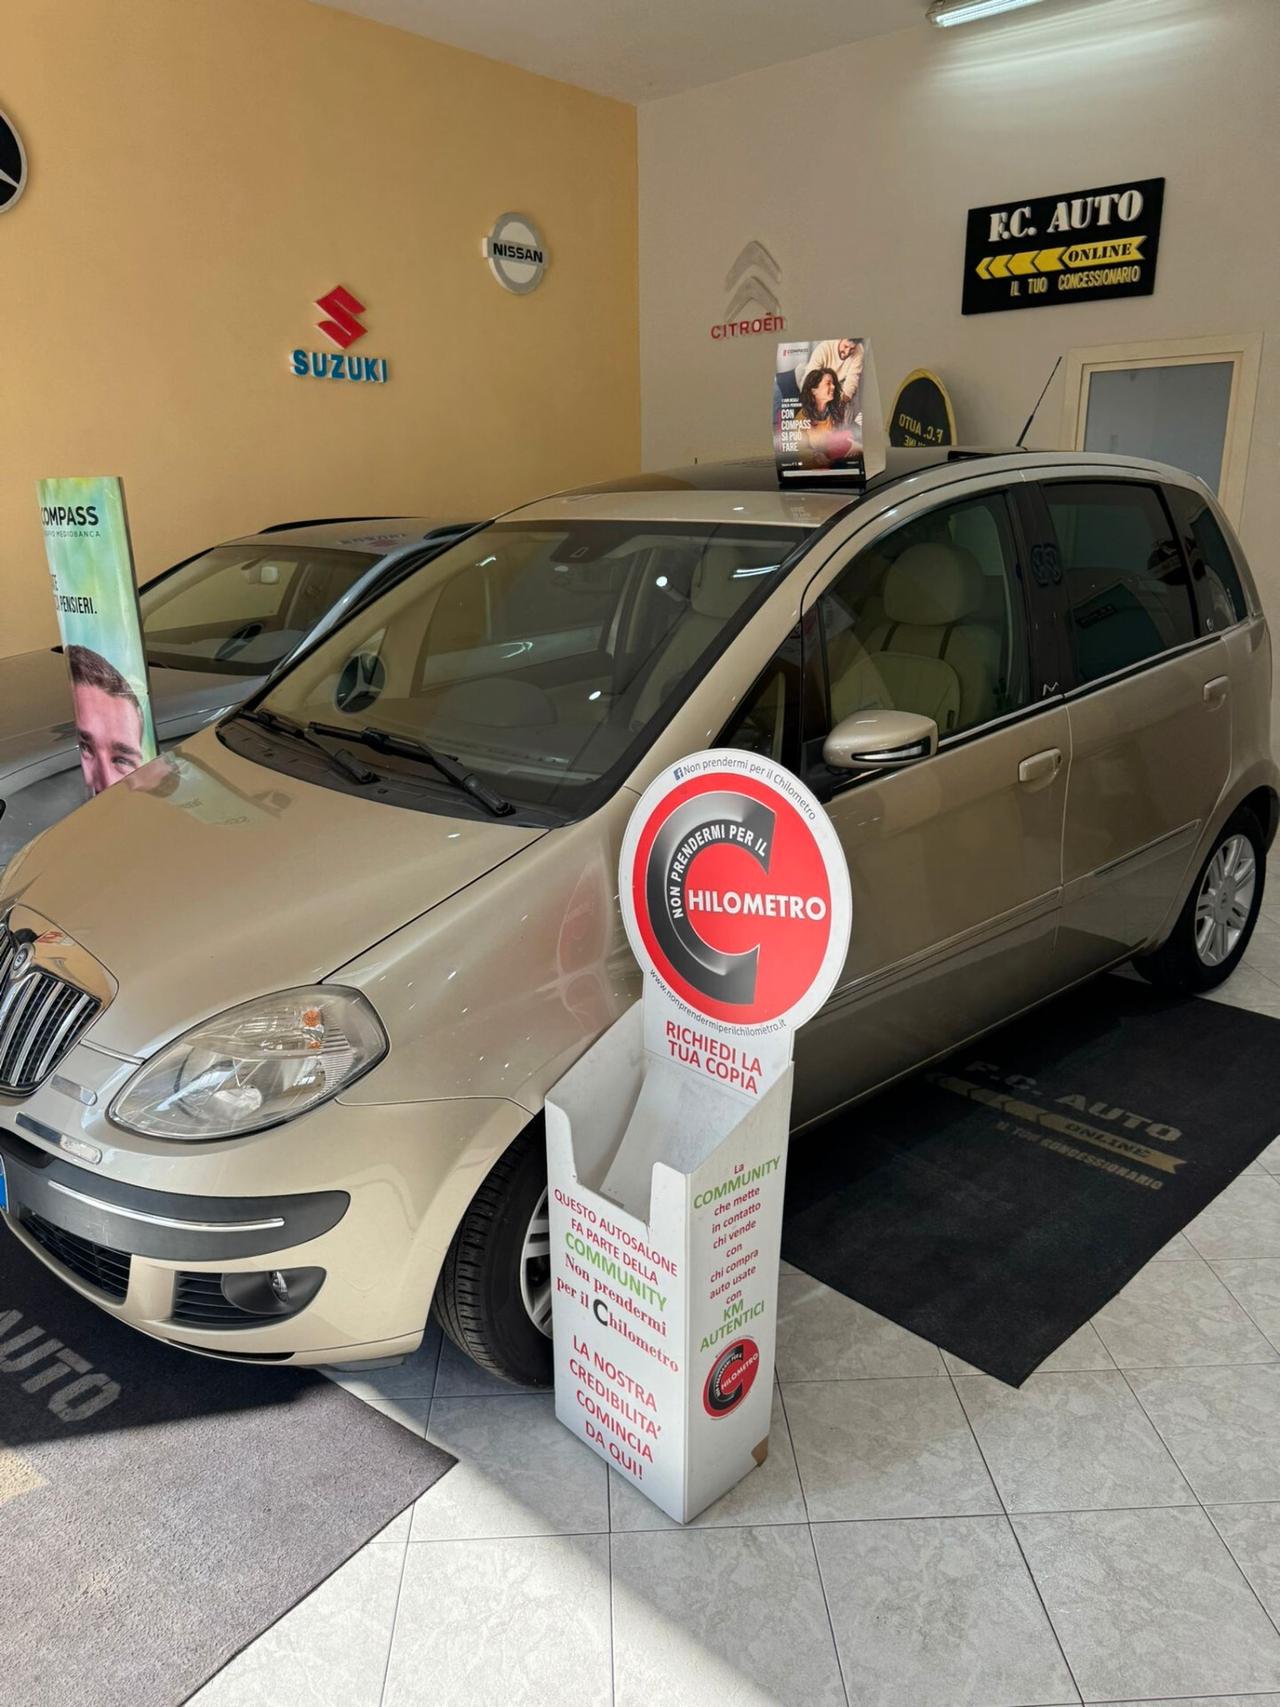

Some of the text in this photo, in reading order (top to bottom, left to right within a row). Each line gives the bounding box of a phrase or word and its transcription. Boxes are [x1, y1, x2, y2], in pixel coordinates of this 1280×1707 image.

[988, 190, 1144, 242] F.C. AUTO
[493, 242, 543, 263] NISSAN
[1068, 243, 1132, 263] ONLINE
[1010, 265, 1141, 296] IL TUO CONCESSIONARIO
[290, 349, 388, 384] SUZUKI
[781, 408, 795, 419] CON
[781, 419, 811, 430] COMPASS
[782, 441, 799, 452] FARE
[683, 761, 701, 775] Non
[702, 756, 748, 770] prendermi
[750, 763, 764, 776] per
[767, 769, 774, 780] il
[774, 774, 816, 821] Chilometro
[669, 823, 768, 919] NON PRENDERMI PER IL
[650, 969, 787, 1037] www.nonprendermiperilchilometro.it
[666, 1020, 762, 1077] RICHIEDI LA
[668, 1040, 758, 1094] TUA COPIA
[1053, 1093, 1183, 1142] AUTO
[1065, 1122, 1151, 1158] ONLINE
[694, 1155, 780, 1209] COMMUNITY
[734, 1163, 745, 1175] La
[1040, 1136, 1164, 1190] CONCESSIONARIO
[712, 1202, 761, 1234] in contatto
[714, 1187, 760, 1217] che mette
[554, 1189, 678, 1277] QUESTO AUTOSALONE
[571, 1218, 658, 1285] FA PARTE DELLA
[713, 1220, 756, 1249] chi vende
[726, 1243, 742, 1258] con
[566, 1232, 667, 1312] COMMUNITY
[710, 1249, 759, 1283] chi compra
[710, 1266, 756, 1300] auto usate
[565, 1253, 667, 1337] Non prendermi
[723, 1298, 744, 1321] KM
[726, 1290, 742, 1305] con
[557, 1277, 679, 1372] per il Chilometro
[700, 1300, 765, 1352] AUTENTICI
[573, 1334, 657, 1412] LA NOSTRA
[576, 1390, 653, 1463] COMINCIA
[585, 1420, 643, 1480] DA QUI!
